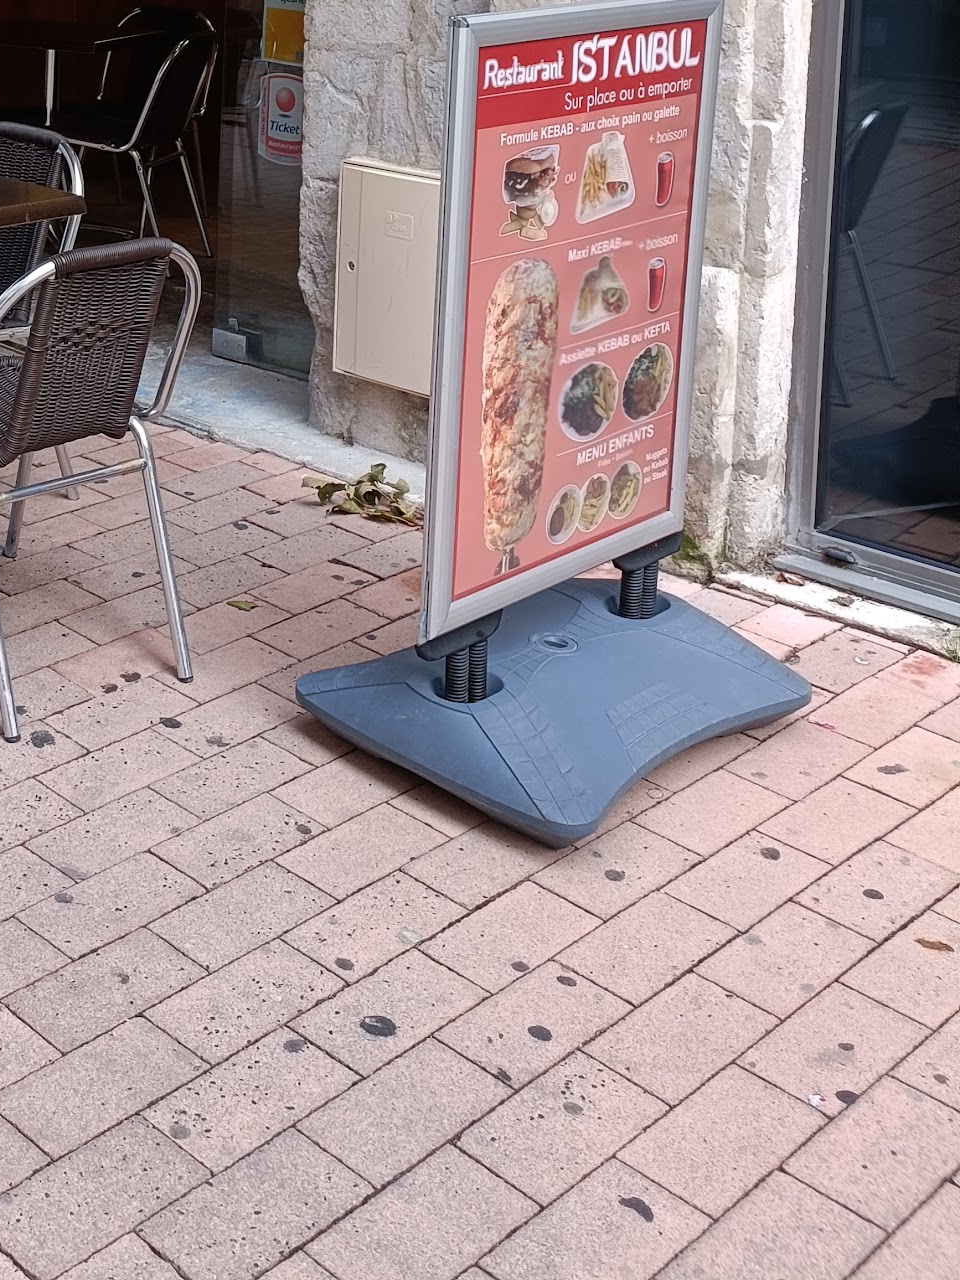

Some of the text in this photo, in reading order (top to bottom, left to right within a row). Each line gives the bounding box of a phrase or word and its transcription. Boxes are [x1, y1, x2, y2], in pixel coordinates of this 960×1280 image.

[483, 27, 700, 90] Restaurant ISTANBUL
[565, 78, 692, 112] Sur place ou à emporter
[270, 121, 300, 135] Ticket
[501, 105, 680, 146] Formule KEBAB aux choix pain ou galette
[656, 128, 687, 143] boisson
[568, 247, 589, 262] Maxi
[590, 237, 622, 256] KEBAB
[646, 234, 678, 250] boisson
[559, 321, 671, 365] Assiette KEBAB ou KEFTA
[577, 424, 654, 466] MENU ENFANTS
[646, 447, 668, 461] Nuggets
[651, 458, 668, 470] Kebab
[652, 469, 668, 480] Steak
